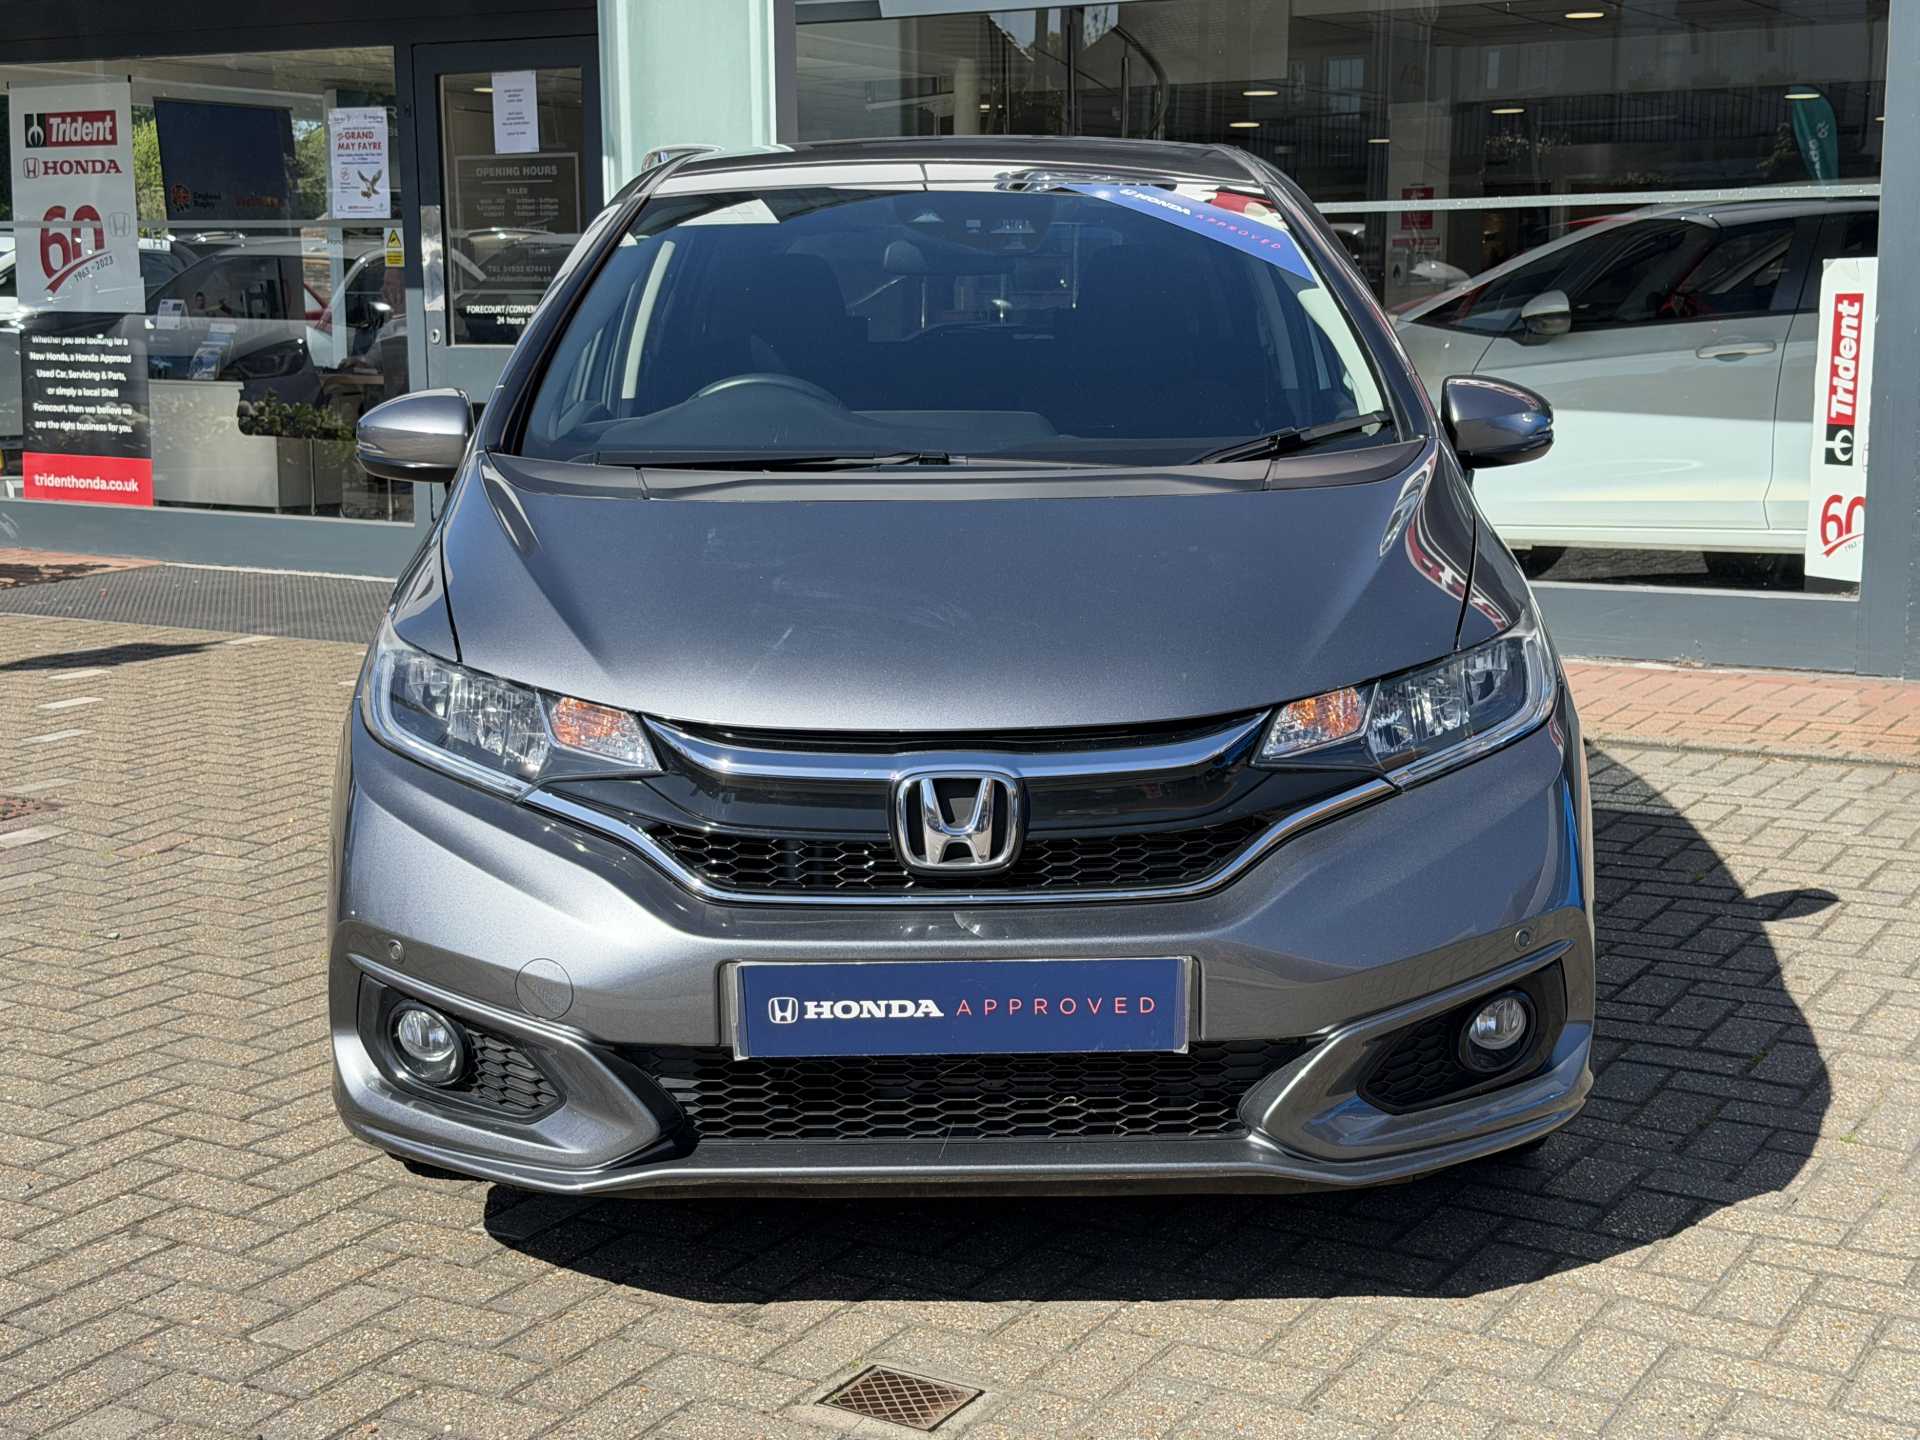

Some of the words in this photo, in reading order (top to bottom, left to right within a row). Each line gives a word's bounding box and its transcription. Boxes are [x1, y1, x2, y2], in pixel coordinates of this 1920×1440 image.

[49, 115, 113, 142] Trident
[344, 131, 374, 140] GRAND
[337, 142, 355, 151] MAY
[358, 142, 382, 150] FAYRE
[42, 159, 122, 176] HONDA
[476, 166, 520, 177] OPENING
[523, 165, 558, 176] HOURS
[62, 337, 74, 346] you
[29, 352, 45, 360] New
[75, 353, 99, 362] Honda
[100, 354, 132, 364] Approved
[1831, 299, 1860, 419] Trident
[36, 369, 54, 378] Used
[68, 370, 100, 381] Servicing
[56, 386, 77, 398] simply
[83, 387, 100, 397] local
[101, 388, 118, 397] Shell
[68, 403, 84, 413] then
[85, 405, 96, 413] we
[48, 420, 60, 430] the
[60, 421, 75, 432] right
[77, 421, 107, 431] business
[34, 473, 139, 492] tridenthonda.co.uk
[805, 999, 944, 1019] HONDA
[956, 996, 1156, 1017] APPROVED
